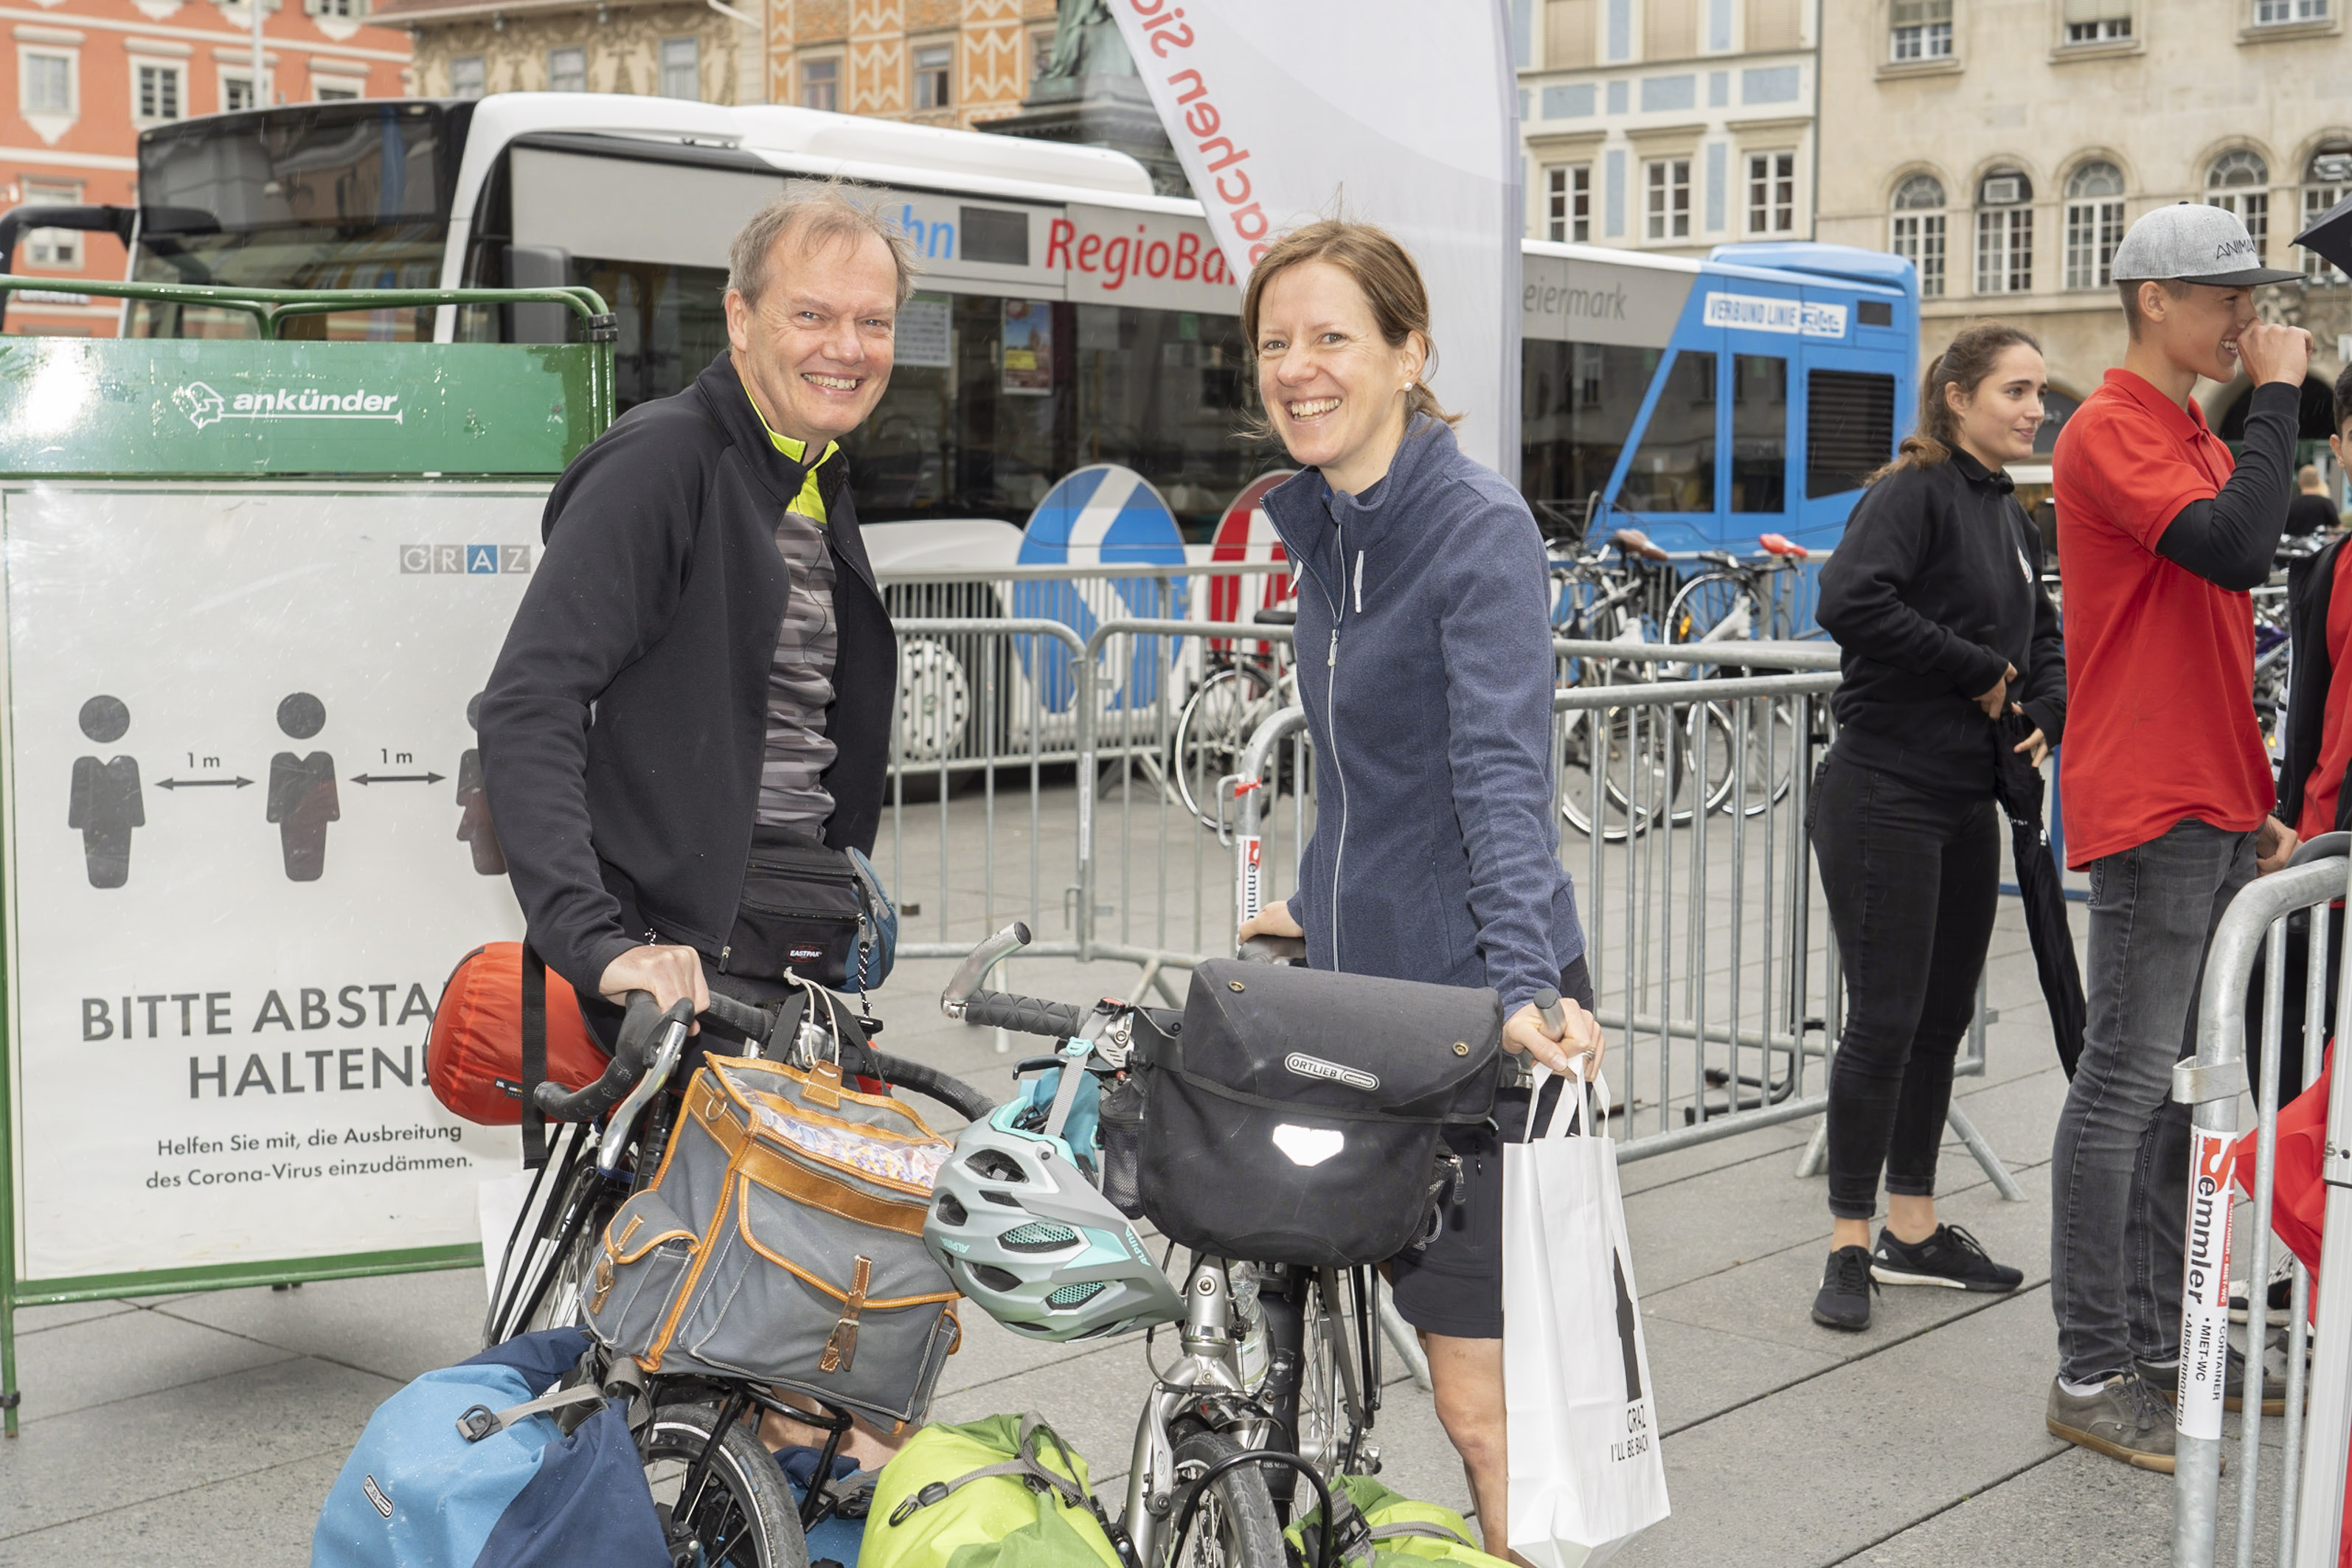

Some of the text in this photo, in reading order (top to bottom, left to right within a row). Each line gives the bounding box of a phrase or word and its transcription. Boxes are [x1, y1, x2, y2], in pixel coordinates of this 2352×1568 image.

[1045, 218, 1236, 290] RegioBa
[1710, 298, 1765, 324] VERBUND
[1767, 304, 1797, 327] LINIE
[233, 388, 398, 412] ankünder
[404, 547, 525, 572] GRAZ
[203, 757, 220, 768] m
[396, 752, 412, 764] m
[790, 950, 820, 958] EASTPAK
[82, 982, 448, 1041] BITTE ABSTA
[1291, 1058, 1338, 1078] ORTLIEB
[158, 1123, 462, 1156] Helfen Sie mit, die Ausbreitung
[146, 1154, 473, 1189] des Corona-Virus einzudämmen.
[2188, 1136, 2238, 1305] Semmler
[2196, 1324, 2211, 1381] MIET-WC
[2213, 1325, 2226, 1401] CONTAINER
[2177, 1319, 2193, 1426] ABSPERRGITTER
[1626, 1404, 1646, 1434] GRAZ
[1627, 1438, 1635, 1458] BE
